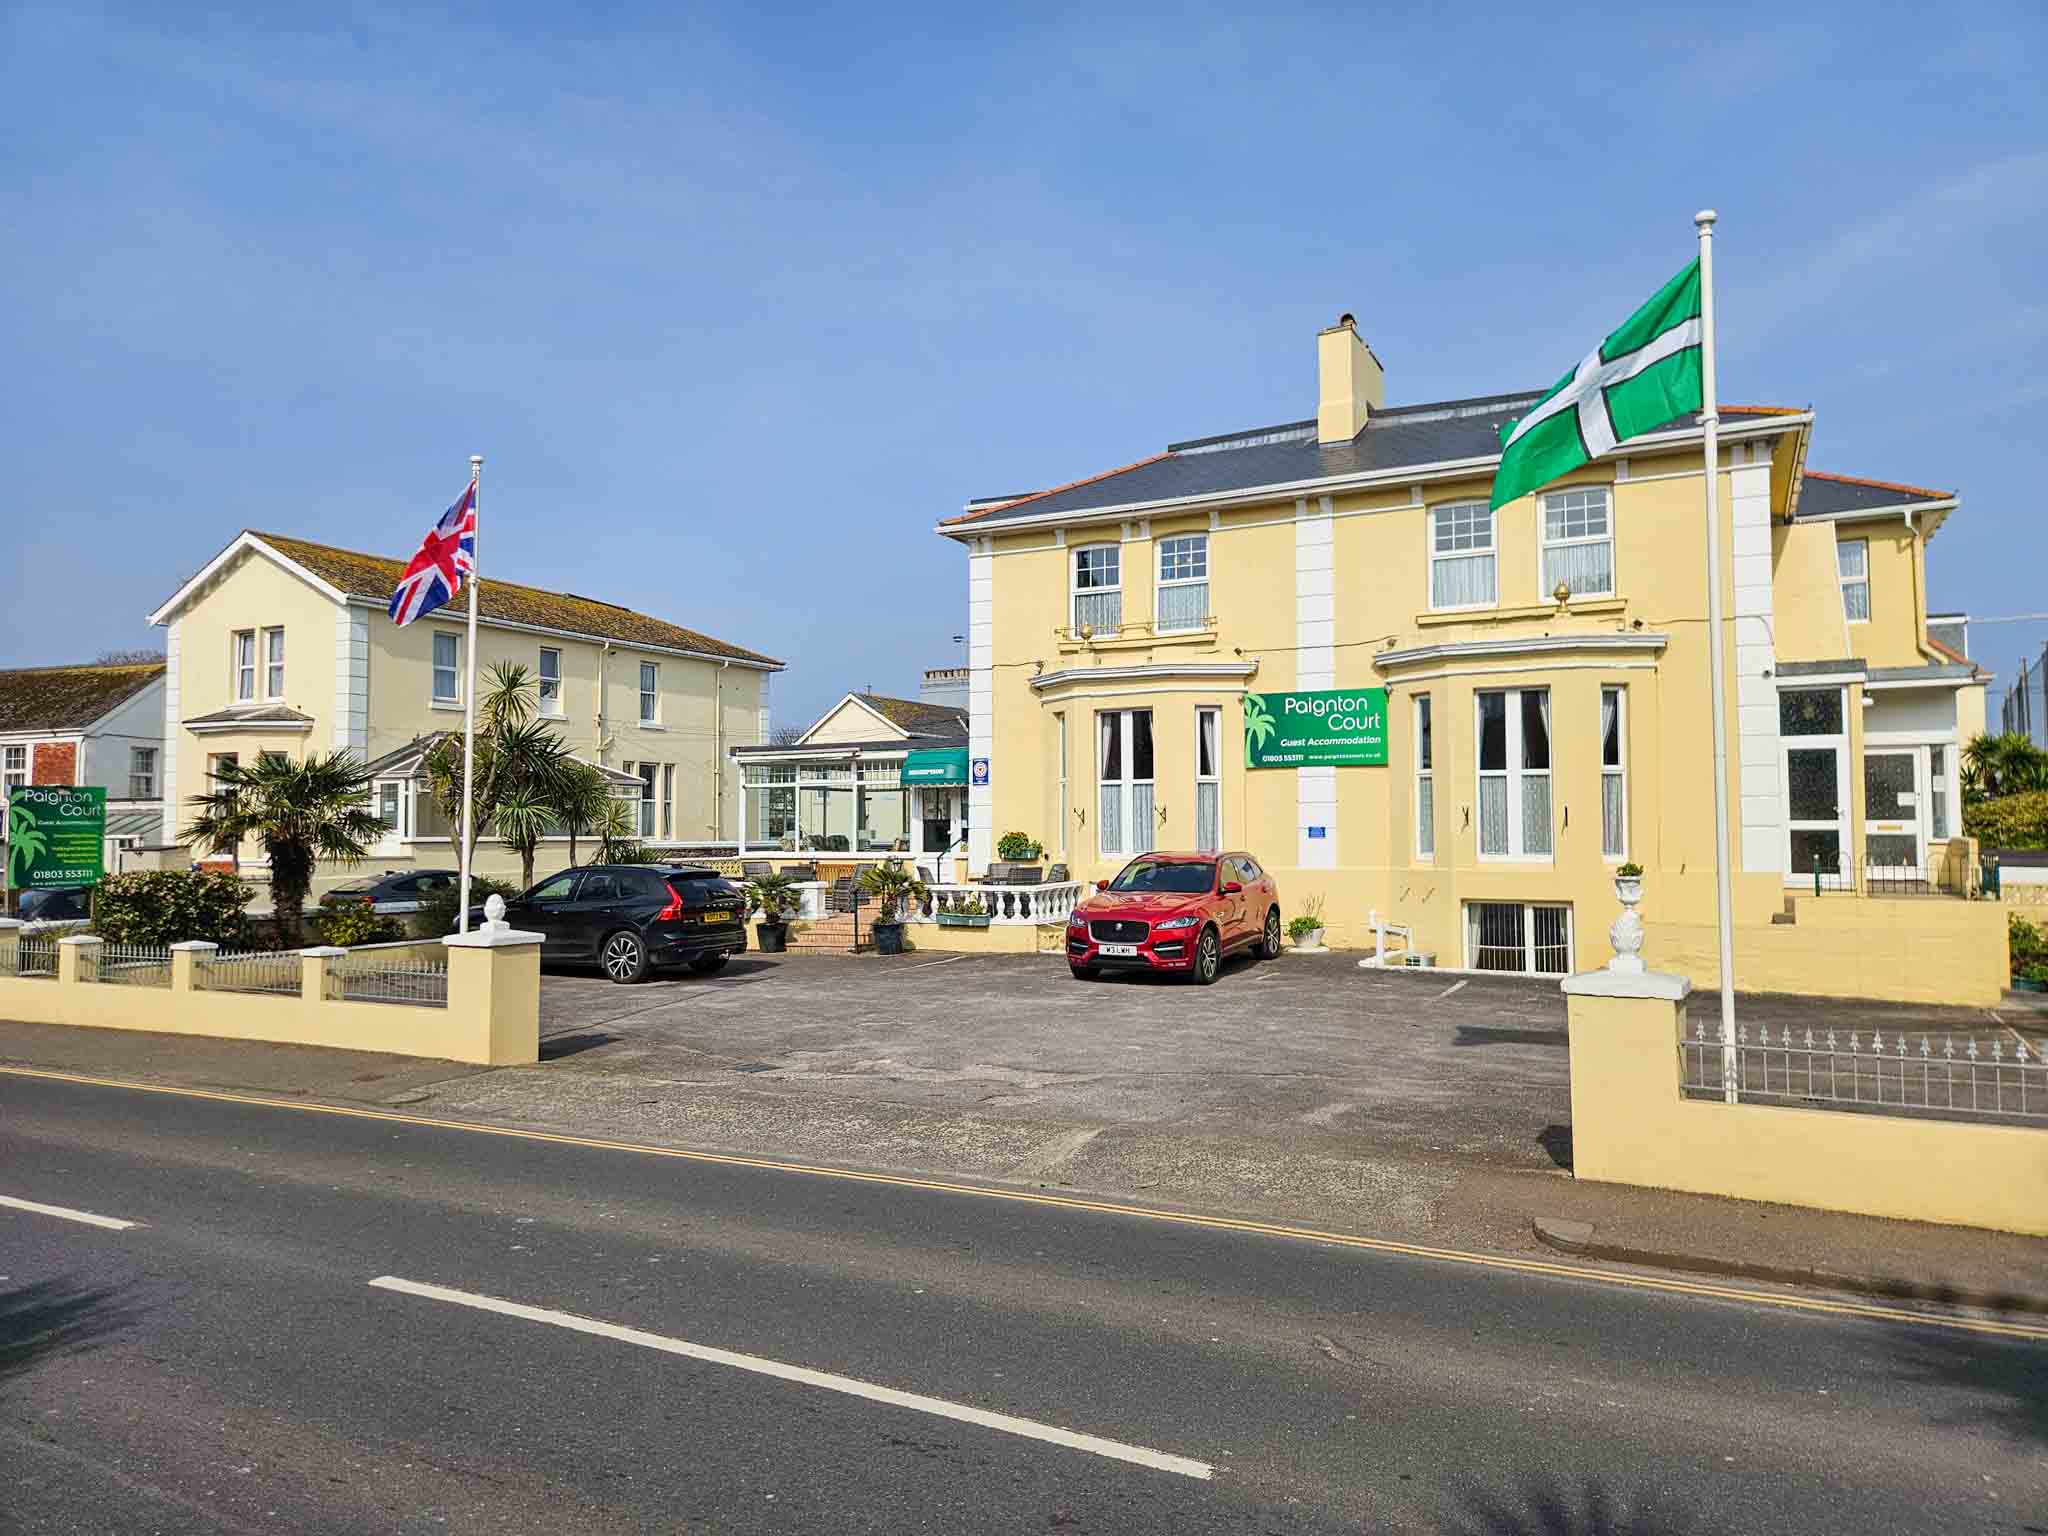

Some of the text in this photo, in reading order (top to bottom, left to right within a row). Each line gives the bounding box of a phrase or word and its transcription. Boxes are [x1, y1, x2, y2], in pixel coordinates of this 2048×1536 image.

[1285, 696, 1368, 717] Paignton
[1328, 712, 1380, 730] Court
[1280, 735, 1381, 747] Guest Accommodation
[25, 789, 93, 805] Paignton
[60, 803, 101, 816] Court
[33, 869, 93, 879] 01803 553111
